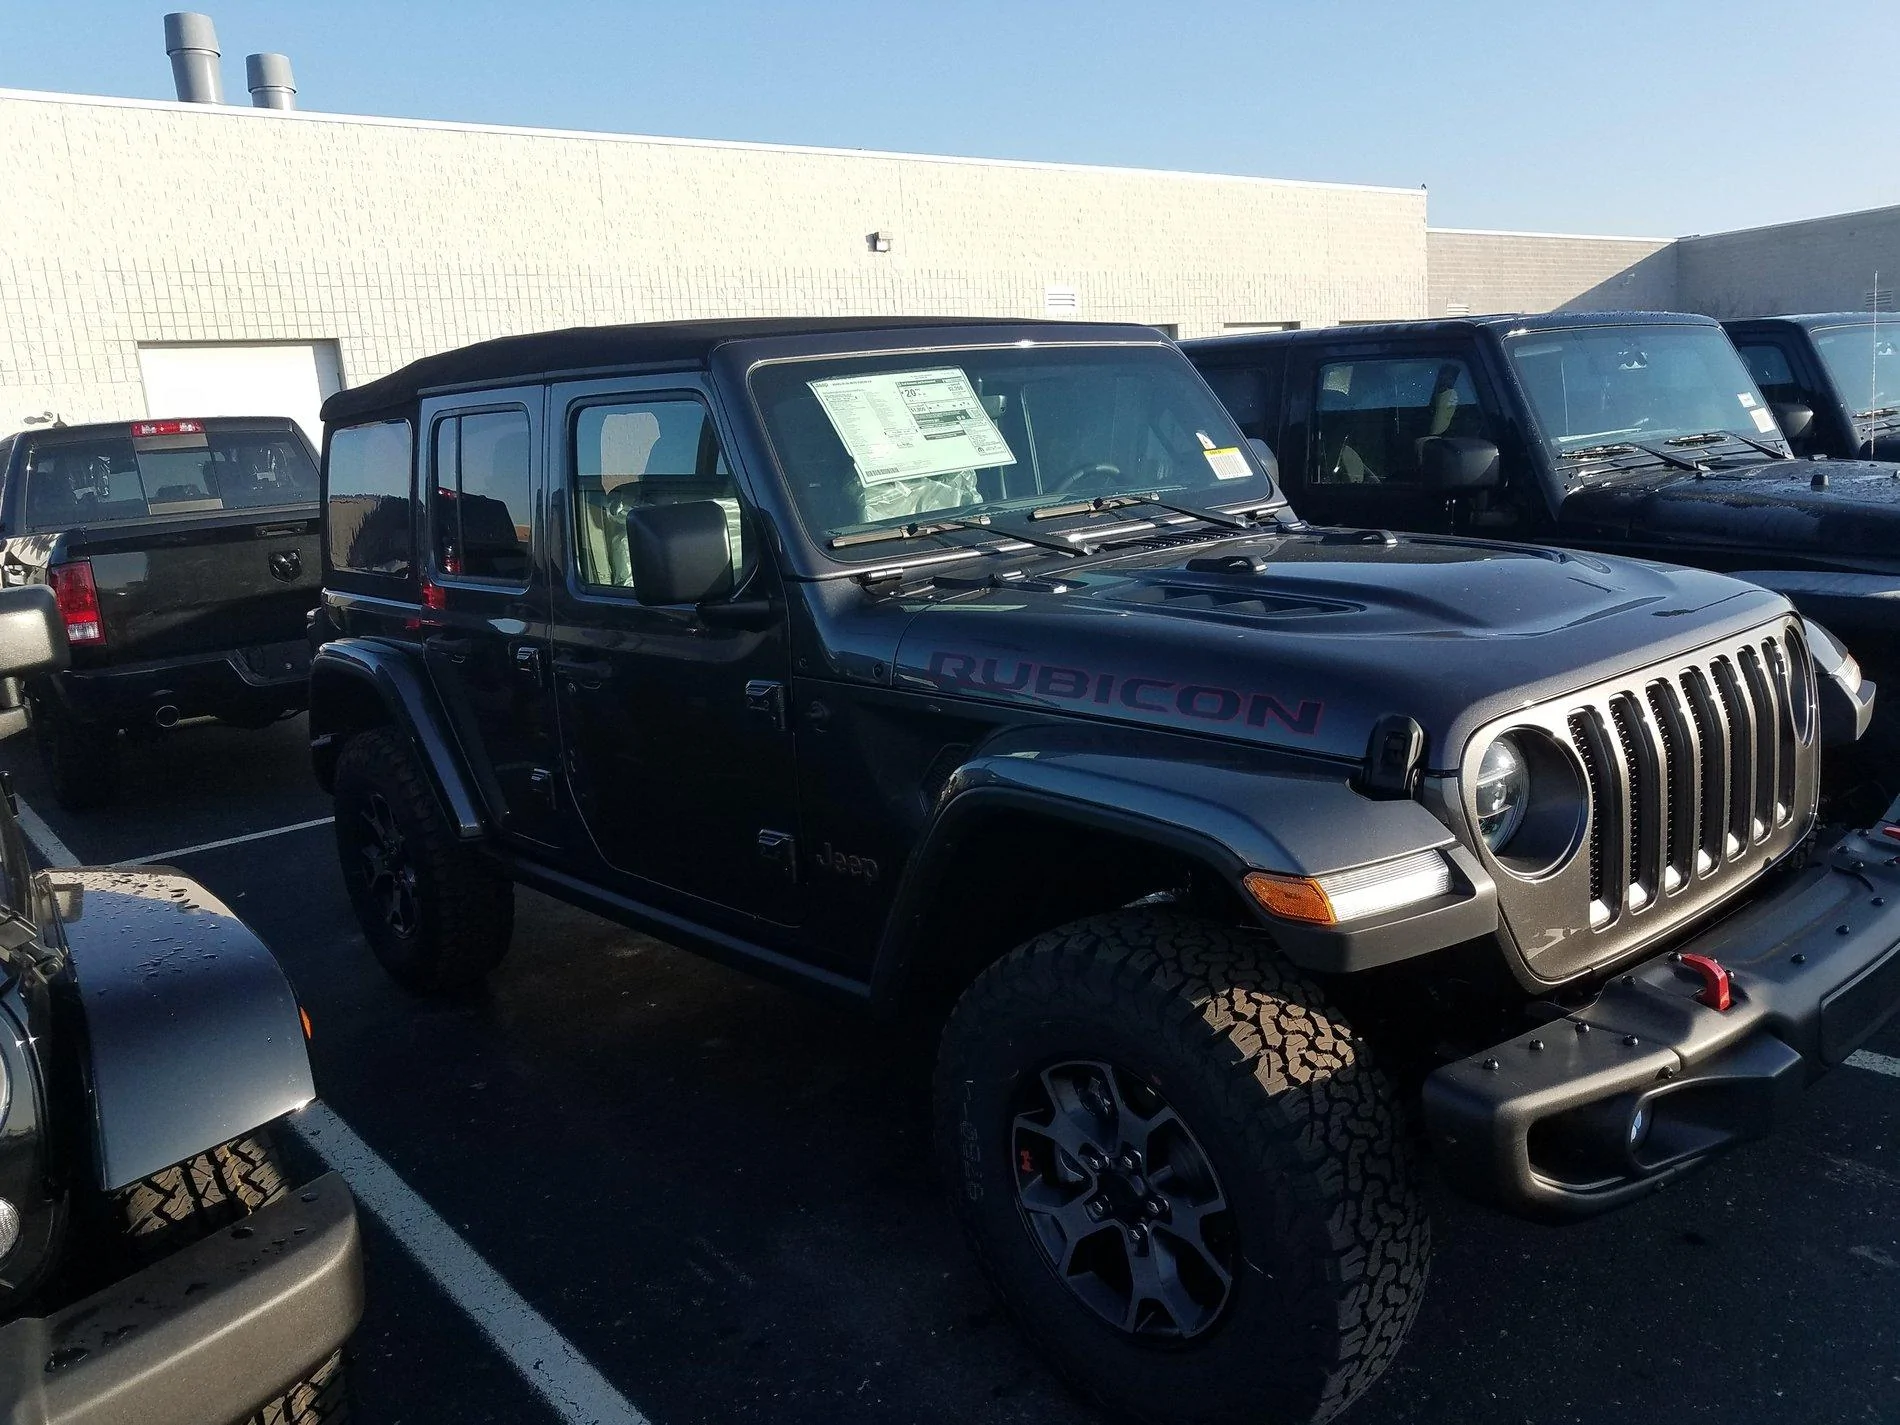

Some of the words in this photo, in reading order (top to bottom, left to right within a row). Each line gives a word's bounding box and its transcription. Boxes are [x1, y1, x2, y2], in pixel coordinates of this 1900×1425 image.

[904, 388, 917, 398] 20
[928, 650, 1325, 737] RUBICON
[815, 841, 880, 885] Jeep
